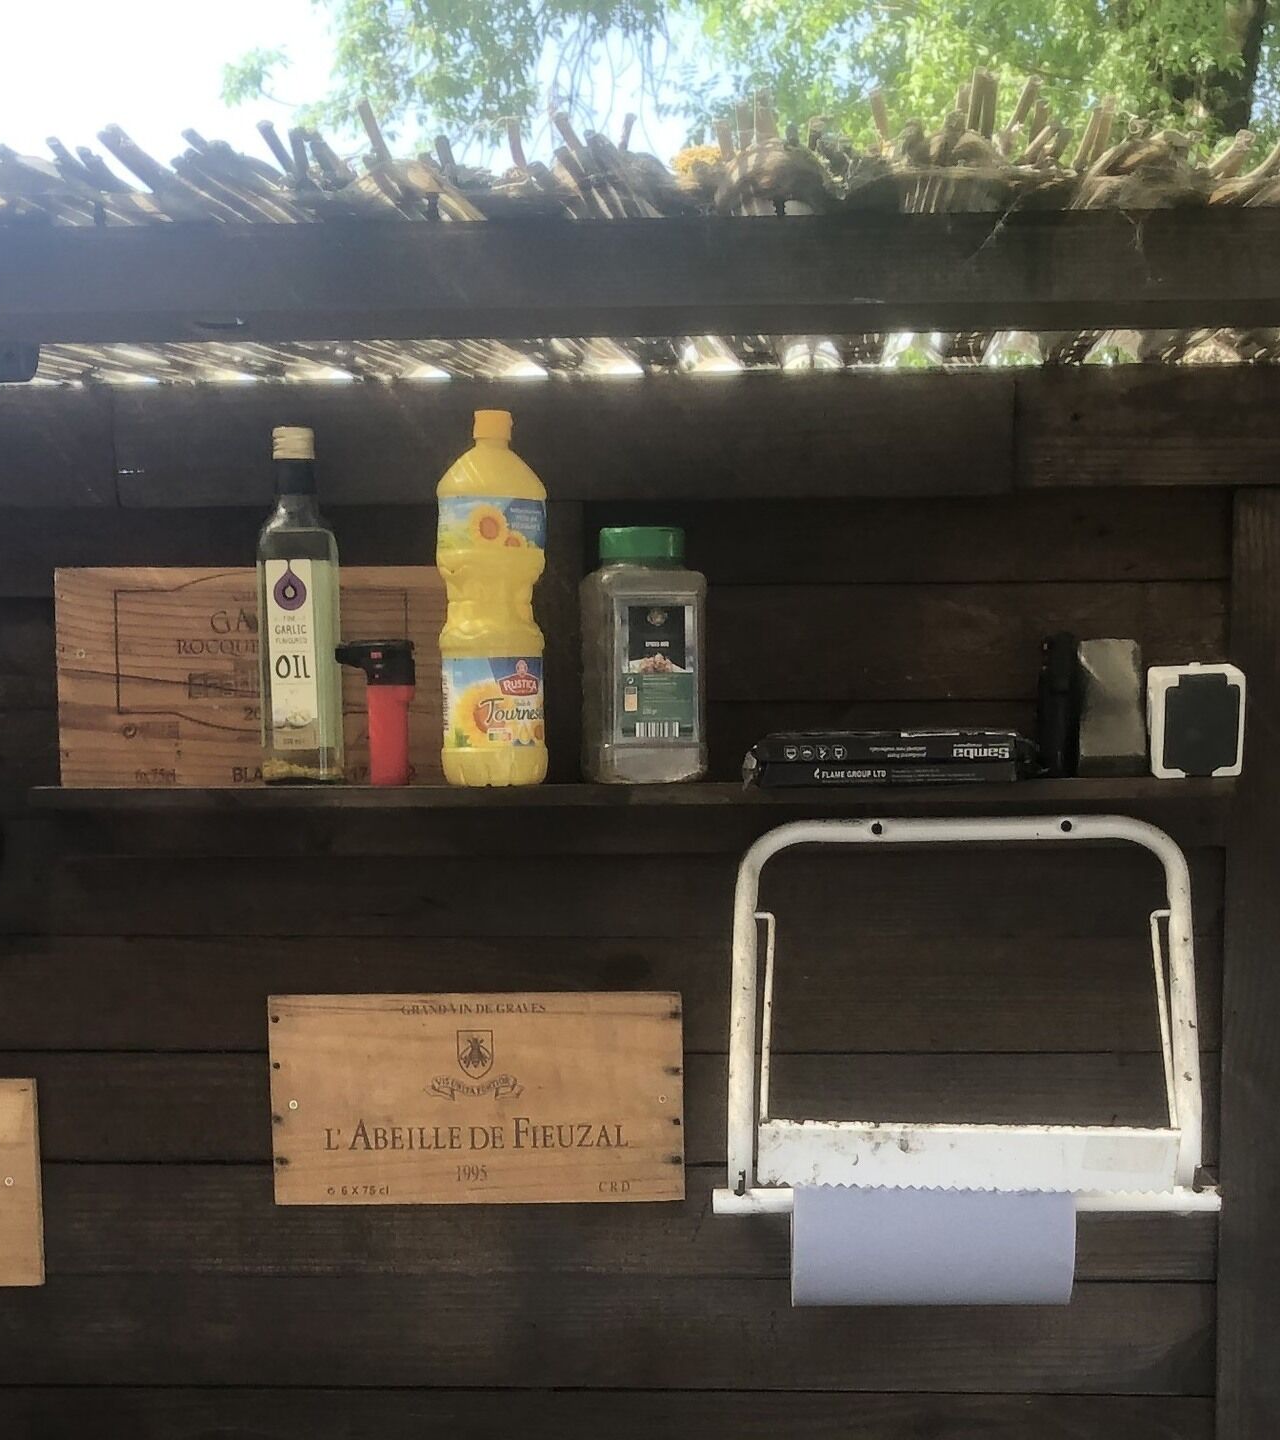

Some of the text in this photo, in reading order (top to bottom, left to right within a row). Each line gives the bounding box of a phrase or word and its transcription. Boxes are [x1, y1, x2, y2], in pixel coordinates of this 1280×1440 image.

[275, 624, 307, 634] GARLIC
[275, 655, 311, 678] OIL
[503, 679, 537, 692] RUSTICA
[952, 747, 1010, 758] Samba
[822, 770, 845, 778] FLAME
[846, 770, 871, 778] GROUP
[872, 770, 887, 778] LTD
[496, 1003, 546, 1014] GRAVES
[470, 1126, 505, 1149] DE
[512, 1116, 630, 1149] FIEUZAL
[456, 1165, 488, 1182] 1995
